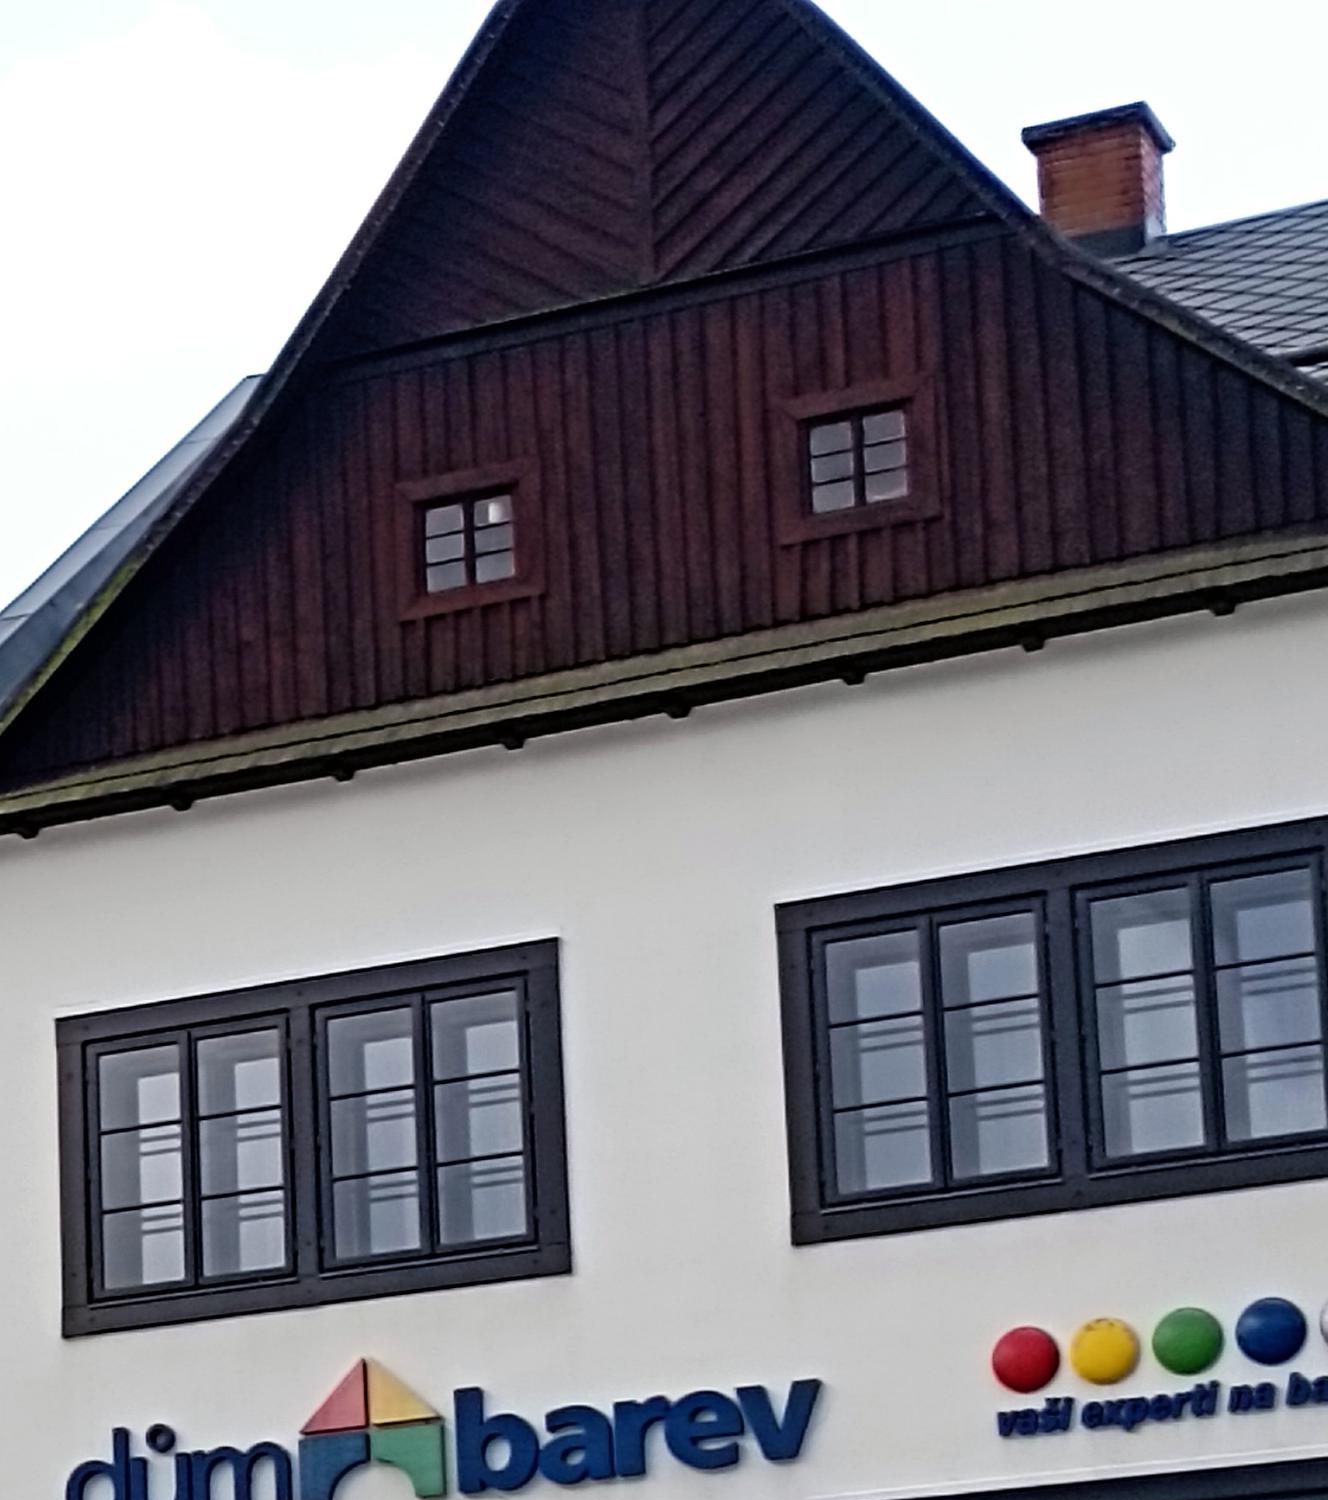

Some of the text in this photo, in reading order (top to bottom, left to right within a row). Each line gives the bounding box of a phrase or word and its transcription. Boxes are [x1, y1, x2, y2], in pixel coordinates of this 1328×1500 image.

[453, 1378, 823, 1495] barev
[997, 1396, 1075, 1437] vaši
[1081, 1380, 1220, 1432] experti
[1228, 1382, 1276, 1413] na
